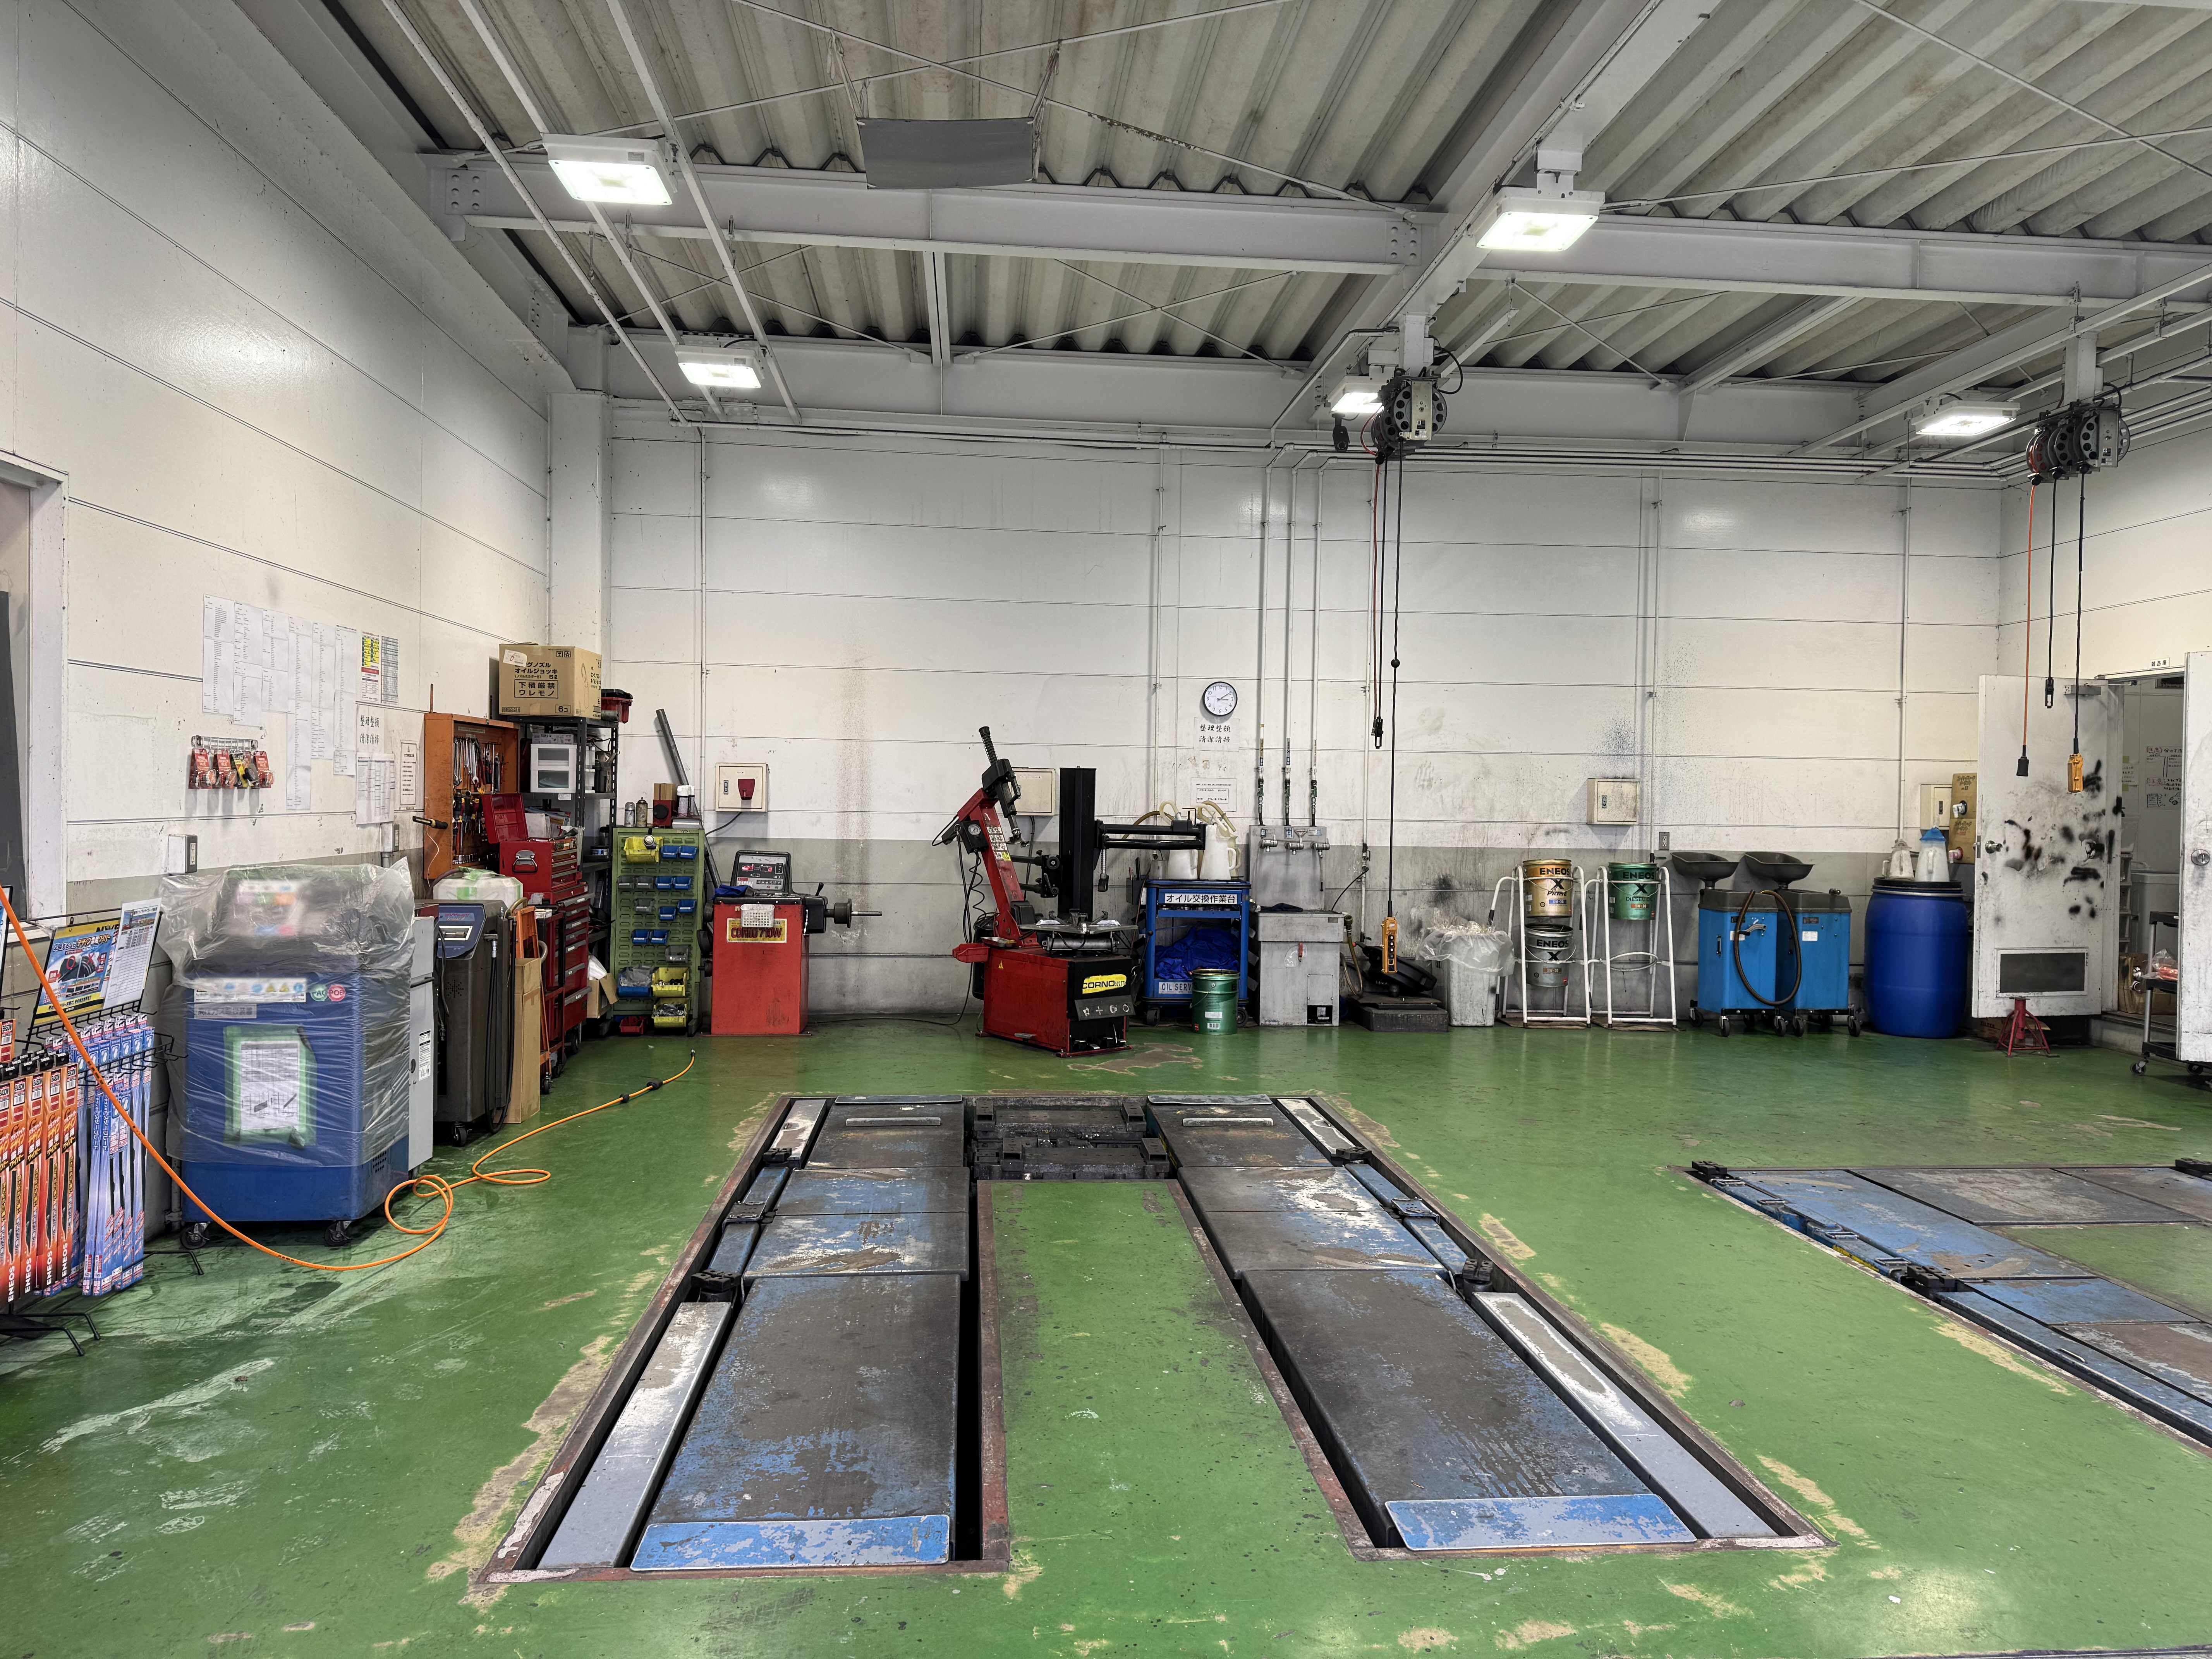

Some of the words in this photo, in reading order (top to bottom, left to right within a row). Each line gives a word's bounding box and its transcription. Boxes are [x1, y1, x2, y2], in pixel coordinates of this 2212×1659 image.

[1200, 724, 1231, 732] 整理整頓
[1199, 735, 1230, 743] 清潔清掃
[1166, 894, 1235, 903] オイル交換作業台
[1537, 939, 1569, 948] ENEOS
[1083, 981, 1115, 989] CORNO
[63, 1136, 76, 1151] ワイパー
[47, 1142, 60, 1157] ワイパー
[27, 1147, 41, 1163] ワイパー
[9, 1154, 24, 1169] ワイパー
